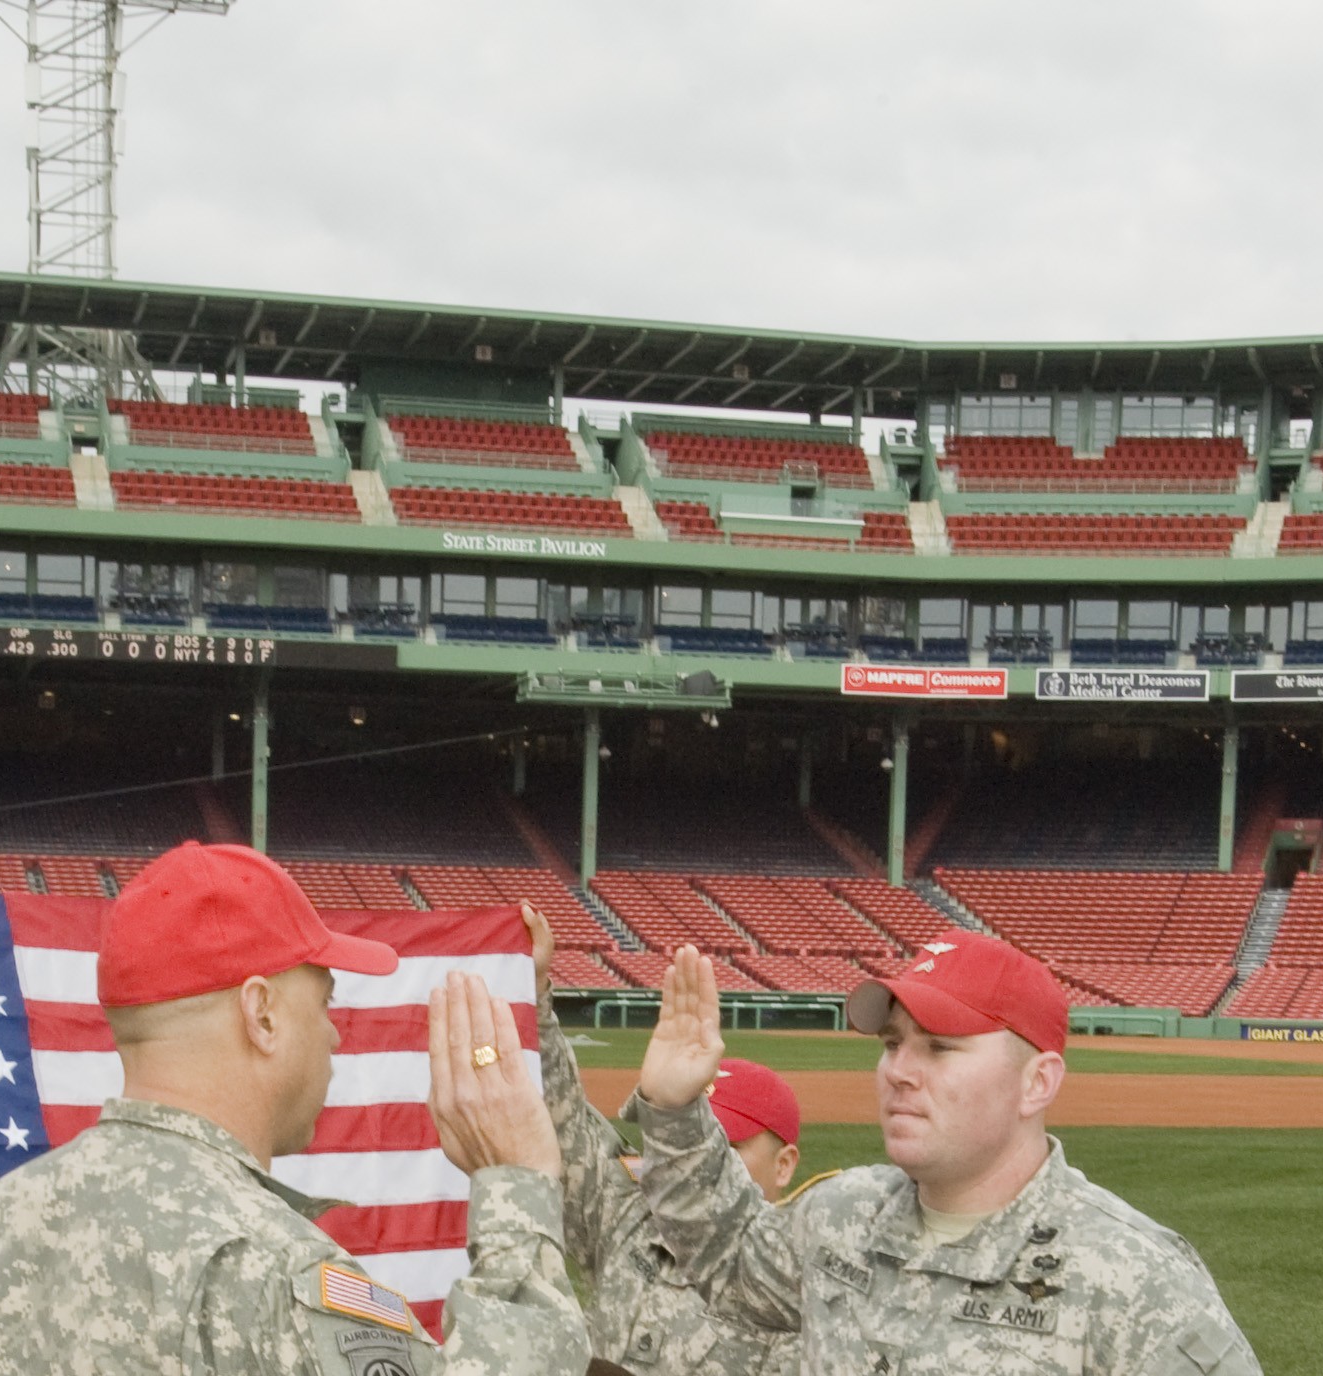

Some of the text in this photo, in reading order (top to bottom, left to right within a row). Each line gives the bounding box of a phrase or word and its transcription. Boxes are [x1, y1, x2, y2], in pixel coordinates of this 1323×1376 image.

[443, 532, 484, 551] STATE
[540, 537, 606, 557] PAVILION
[53, 630, 73, 640] SLG
[175, 635, 200, 649] BOS
[206, 637, 215, 649] 2
[227, 637, 236, 650] 9
[244, 638, 253, 651] 0
[4, 641, 34, 655] .429
[47, 642, 78, 657] .300
[102, 640, 166, 660] 0 0 0
[175, 648, 271, 664] NYY 4 8 0 F
[867, 671, 1001, 687] MAPFRE Commerce
[1069, 673, 1201, 688] Beth Israel Deaconess
[1276, 675, 1296, 689] The
[1069, 684, 1162, 699] Medical Center
[1251, 1028, 1291, 1041] GIANT
[962, 1299, 1047, 1328] U.S. ARMY
[343, 1329, 403, 1344] AIRBORNE
